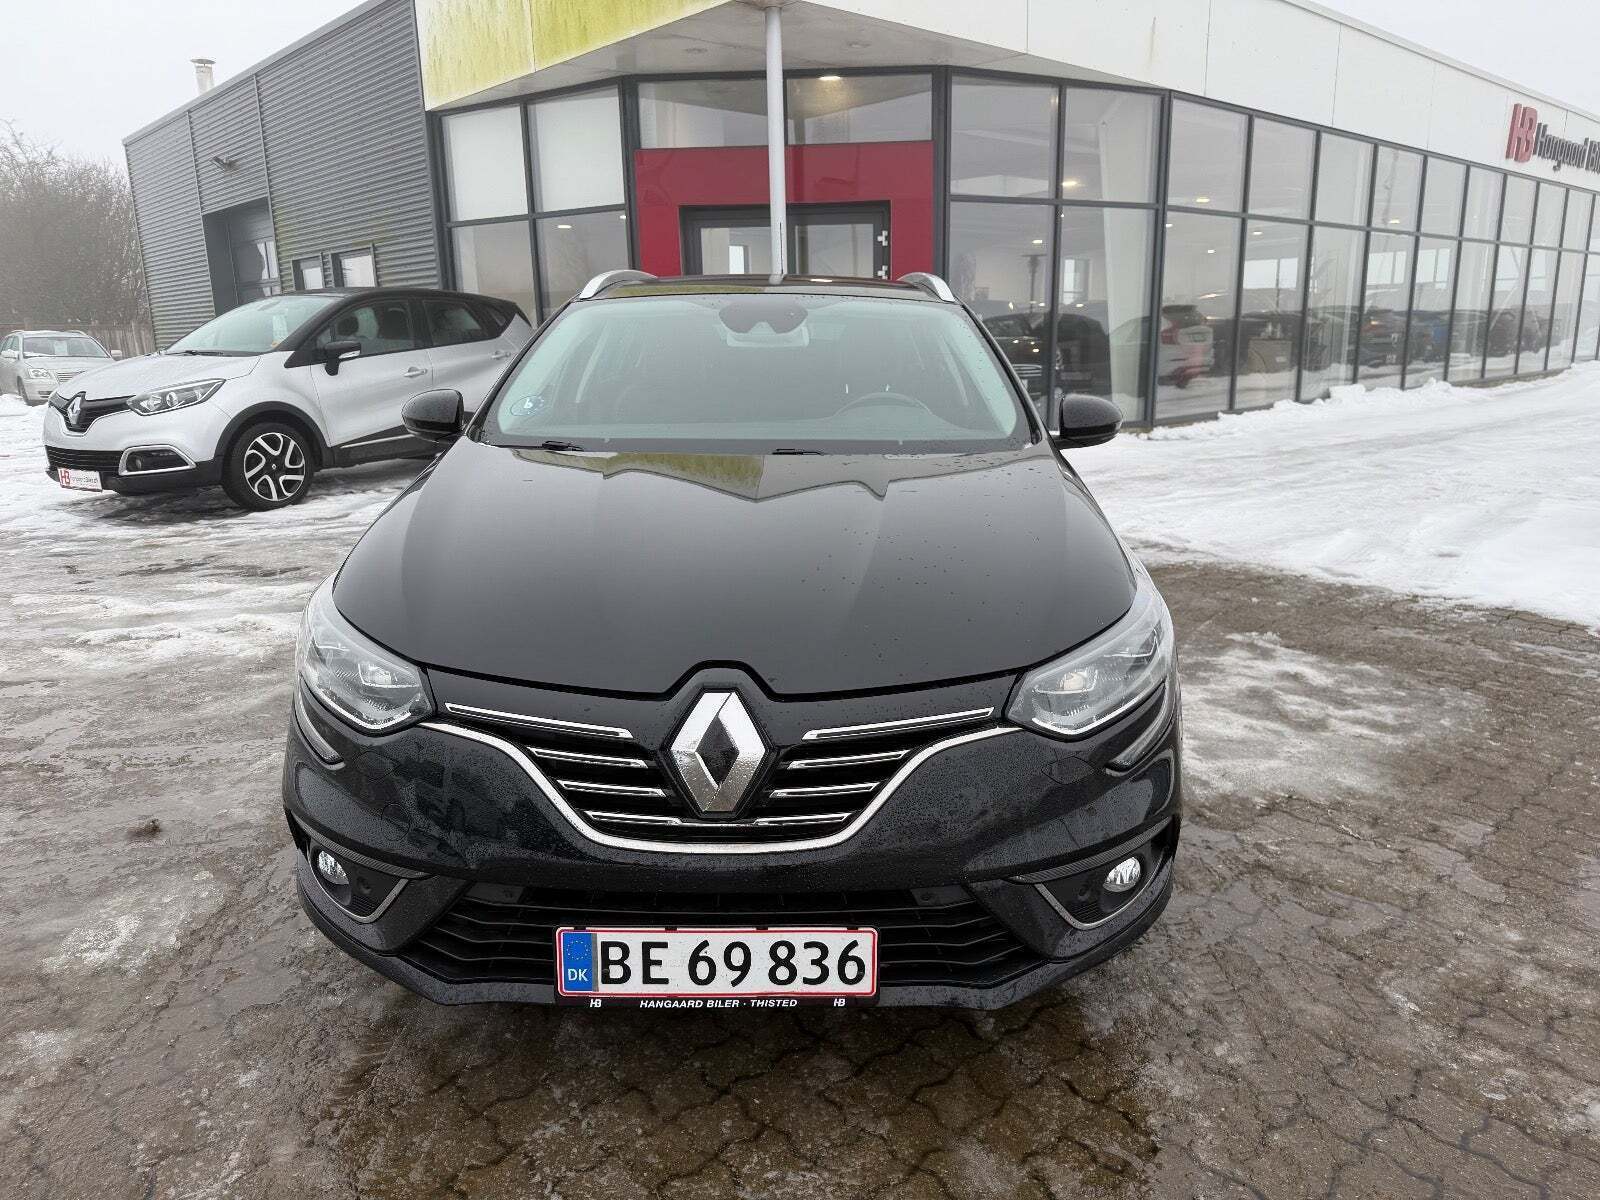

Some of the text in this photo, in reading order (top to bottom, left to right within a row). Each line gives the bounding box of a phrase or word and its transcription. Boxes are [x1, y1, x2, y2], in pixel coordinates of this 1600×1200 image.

[1505, 102, 1538, 163] HB
[567, 968, 588, 981] DK
[600, 939, 866, 988] BE 69 836
[639, 999, 798, 1009] HANGAARD BILER THISTED
